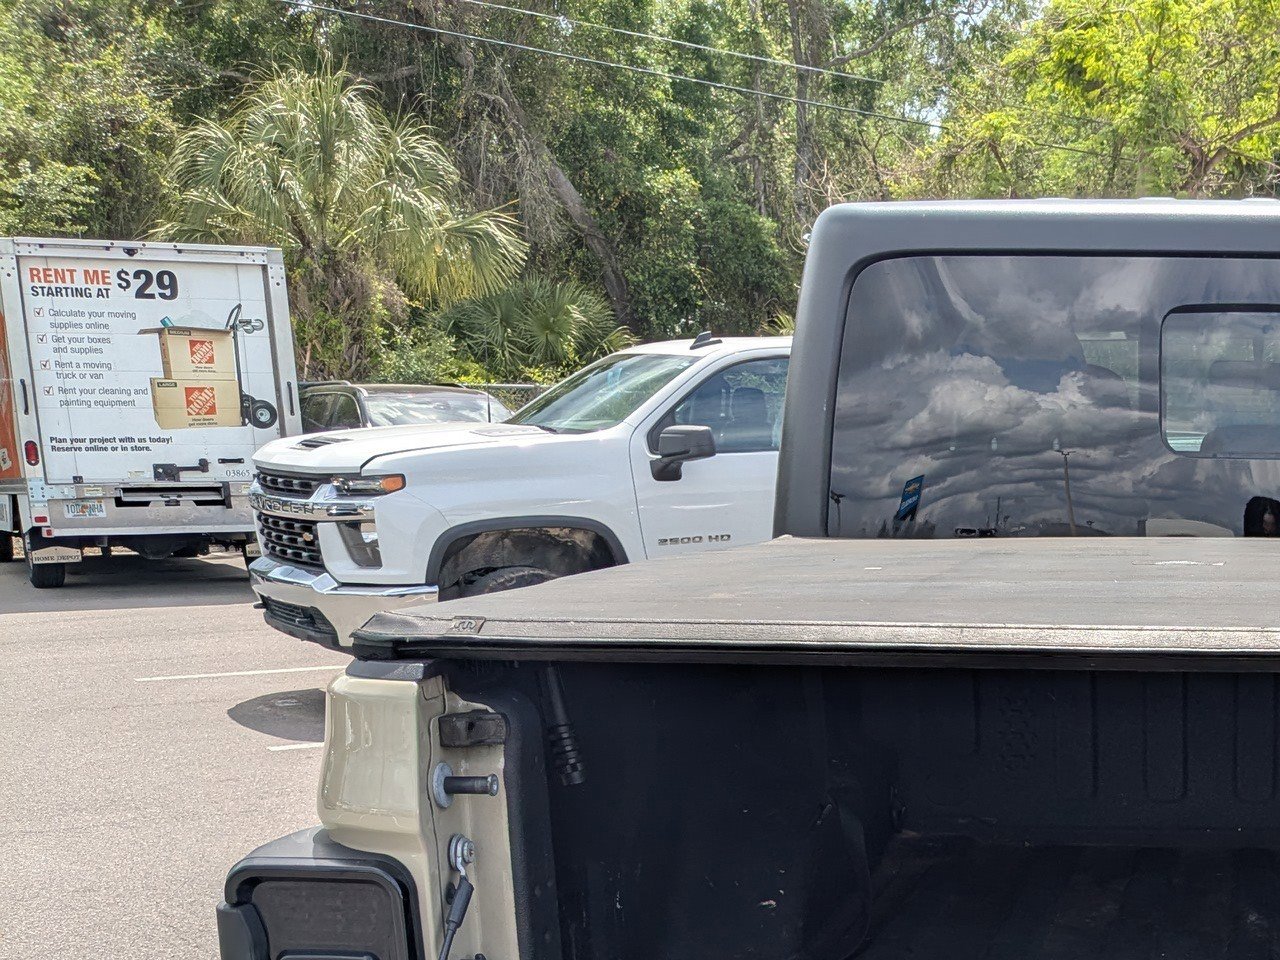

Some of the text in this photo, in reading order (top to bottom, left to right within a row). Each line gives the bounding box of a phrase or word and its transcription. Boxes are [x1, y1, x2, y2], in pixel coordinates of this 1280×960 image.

[29, 267, 112, 286] RENT ME
[116, 268, 179, 301] $29
[30, 285, 111, 299] STARTING AT
[48, 308, 137, 321] Calculate your moving
[49, 321, 110, 331] supplies online
[51, 335, 111, 345] Get your boxes
[53, 345, 104, 355] and supplies
[54, 360, 73, 369] Rent
[83, 362, 112, 371] moving
[56, 371, 77, 380] truck
[89, 372, 104, 380] van
[57, 386, 148, 396] Rent your cleaning and
[59, 399, 136, 408] painting equipment
[187, 386, 216, 415] HOME
[49, 436, 67, 444] Plan
[69, 437, 87, 445] your
[89, 436, 116, 445] project
[149, 436, 173, 445] today!
[225, 469, 250, 477] 03865
[658, 534, 731, 546] 2500 HD
